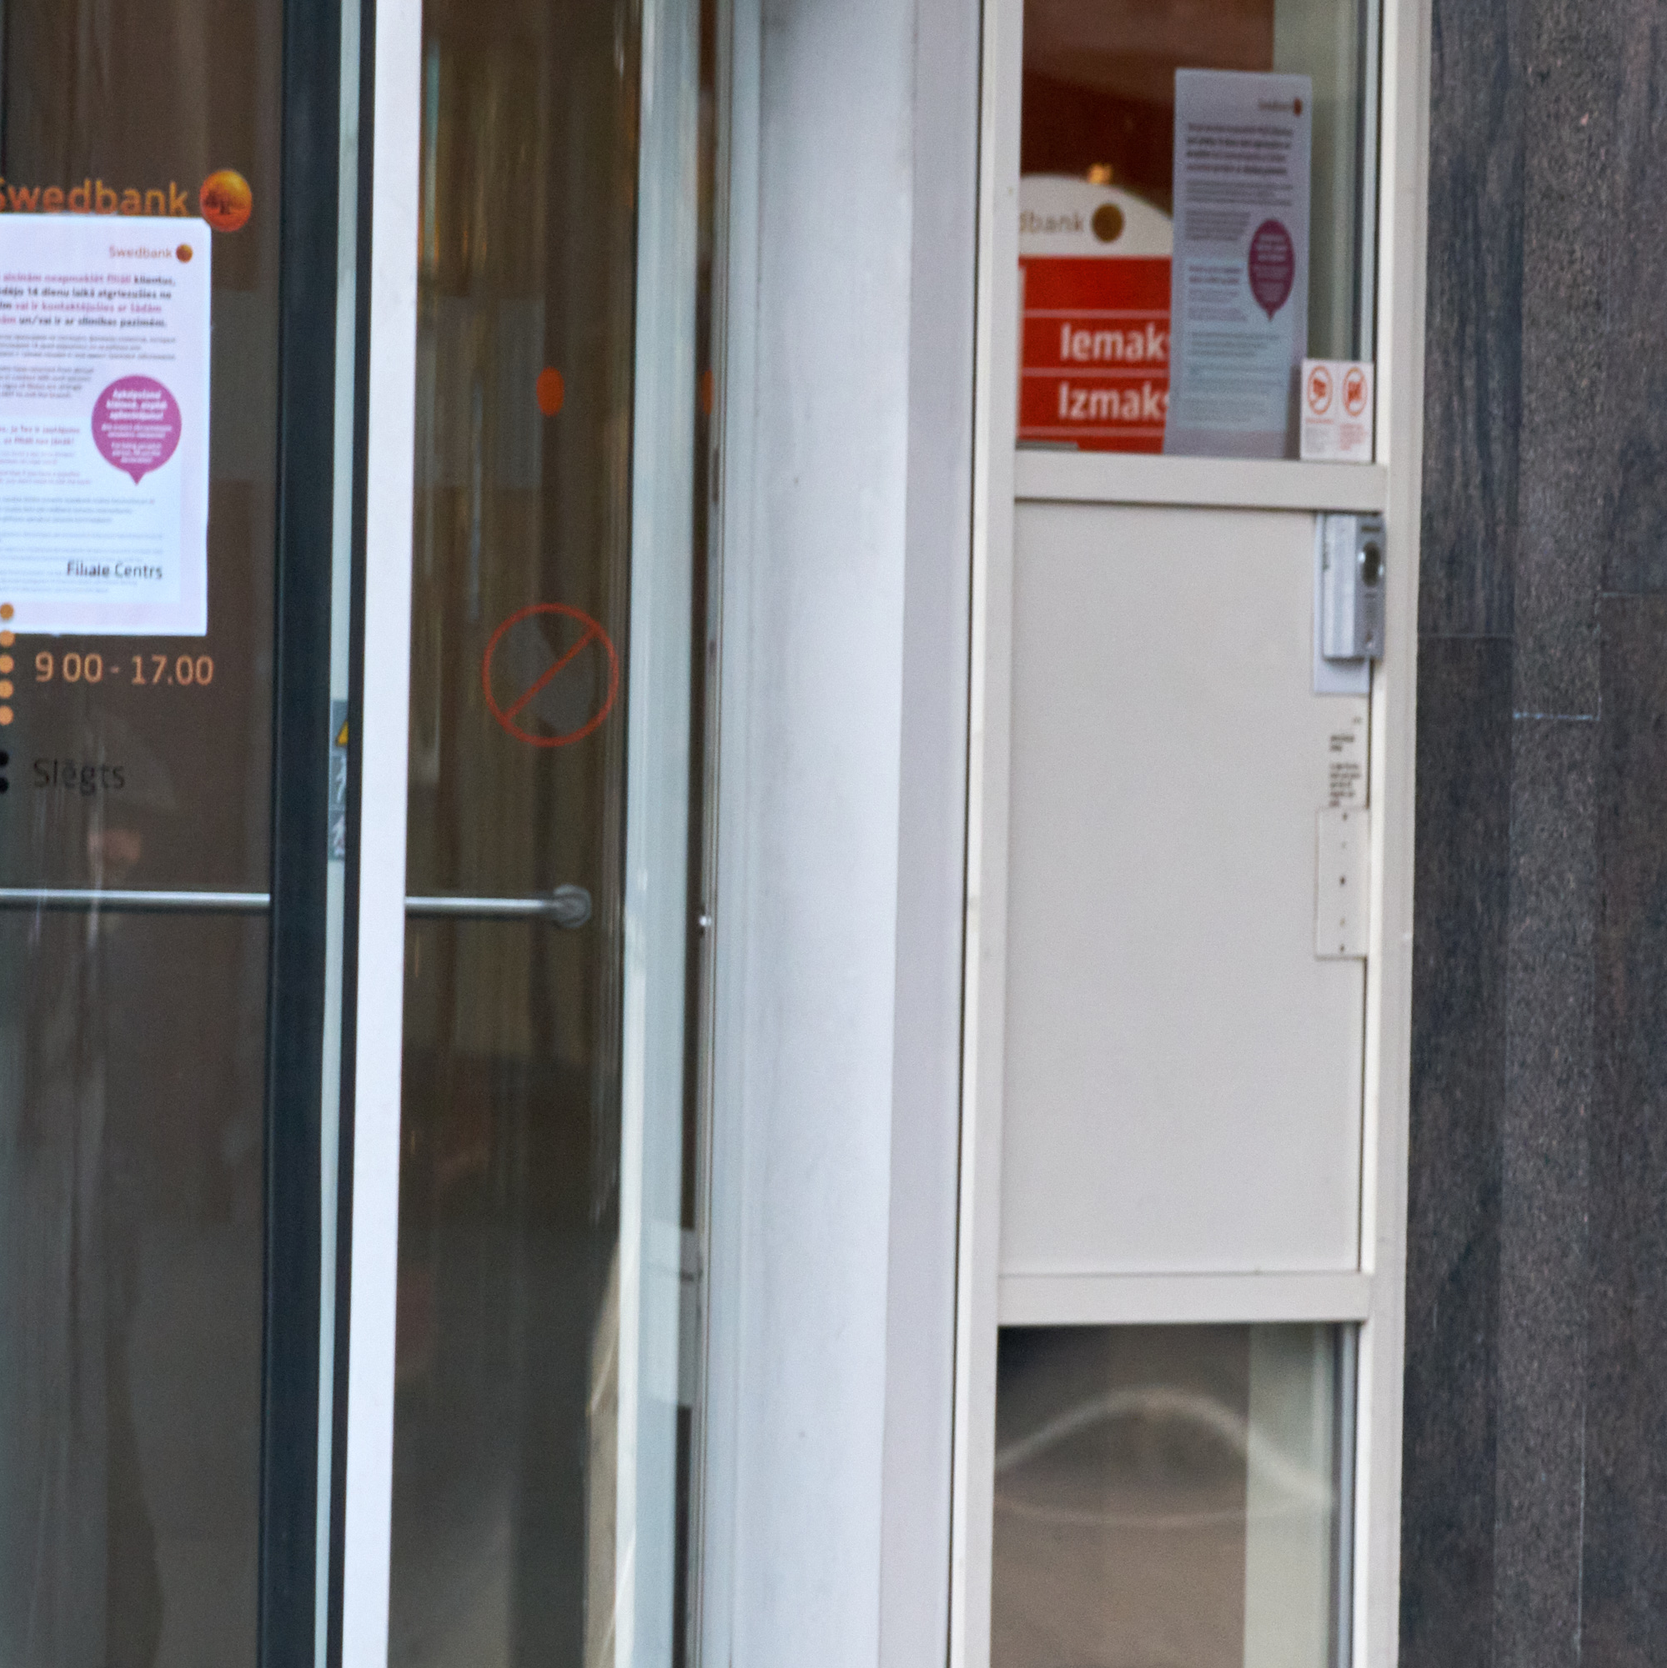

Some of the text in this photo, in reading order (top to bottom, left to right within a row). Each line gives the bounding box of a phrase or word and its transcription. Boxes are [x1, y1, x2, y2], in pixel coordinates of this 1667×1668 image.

[0, 178, 189, 216] wedbank
[109, 245, 173, 259] Swedbank
[1060, 321, 1169, 363] Iemak
[114, 562, 163, 580] Centrs
[131, 655, 214, 685] 17.00
